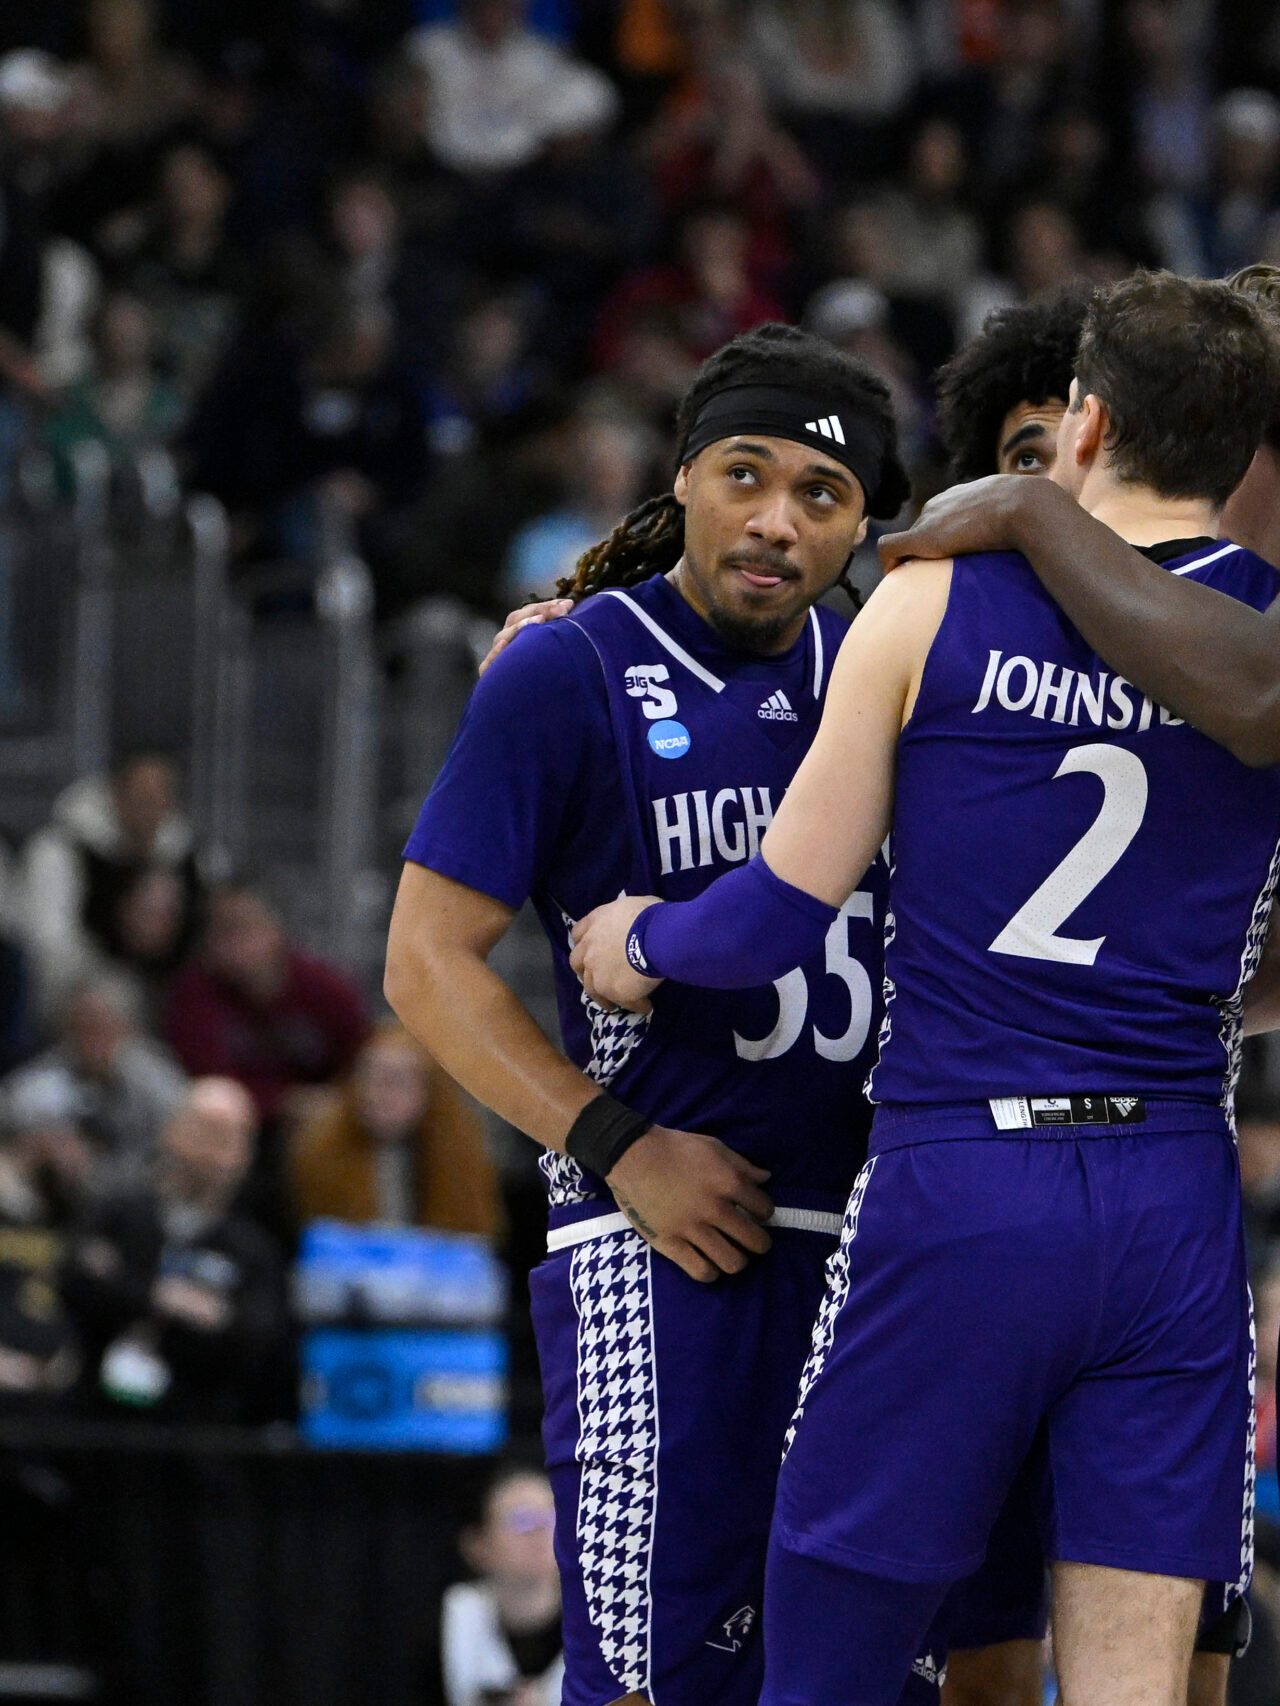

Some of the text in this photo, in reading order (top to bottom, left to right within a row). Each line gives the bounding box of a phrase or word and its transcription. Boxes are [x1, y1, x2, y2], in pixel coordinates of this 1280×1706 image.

[757, 708, 798, 722] adidas
[655, 736, 688, 749] NCAA
[652, 787, 774, 875] HIGH
[988, 743, 1148, 965] 2
[1084, 1098, 1092, 1109] S
